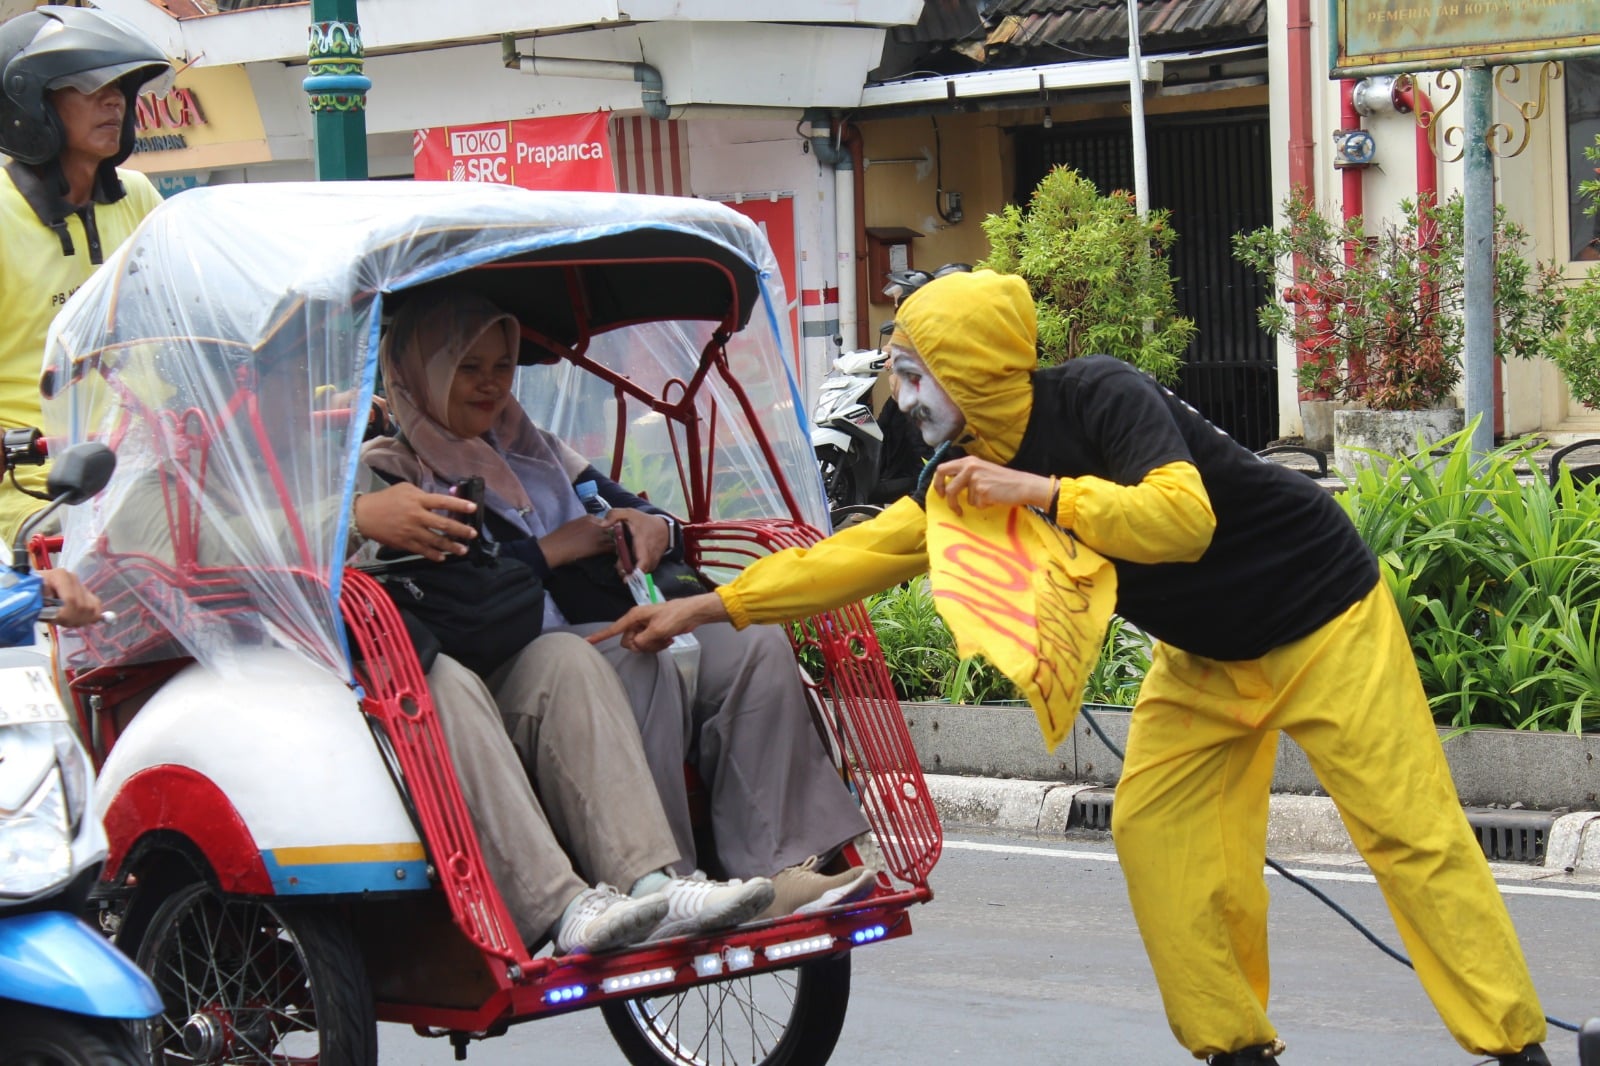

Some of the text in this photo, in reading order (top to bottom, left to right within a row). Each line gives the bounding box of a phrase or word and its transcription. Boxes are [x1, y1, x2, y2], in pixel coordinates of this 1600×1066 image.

[1366, 4, 1459, 23] PEMERINTAH
[134, 87, 206, 131] NCA
[455, 131, 501, 153] TOKO
[516, 142, 603, 168] Prapanca
[467, 157, 507, 182] SRC
[52, 292, 66, 307] PB
